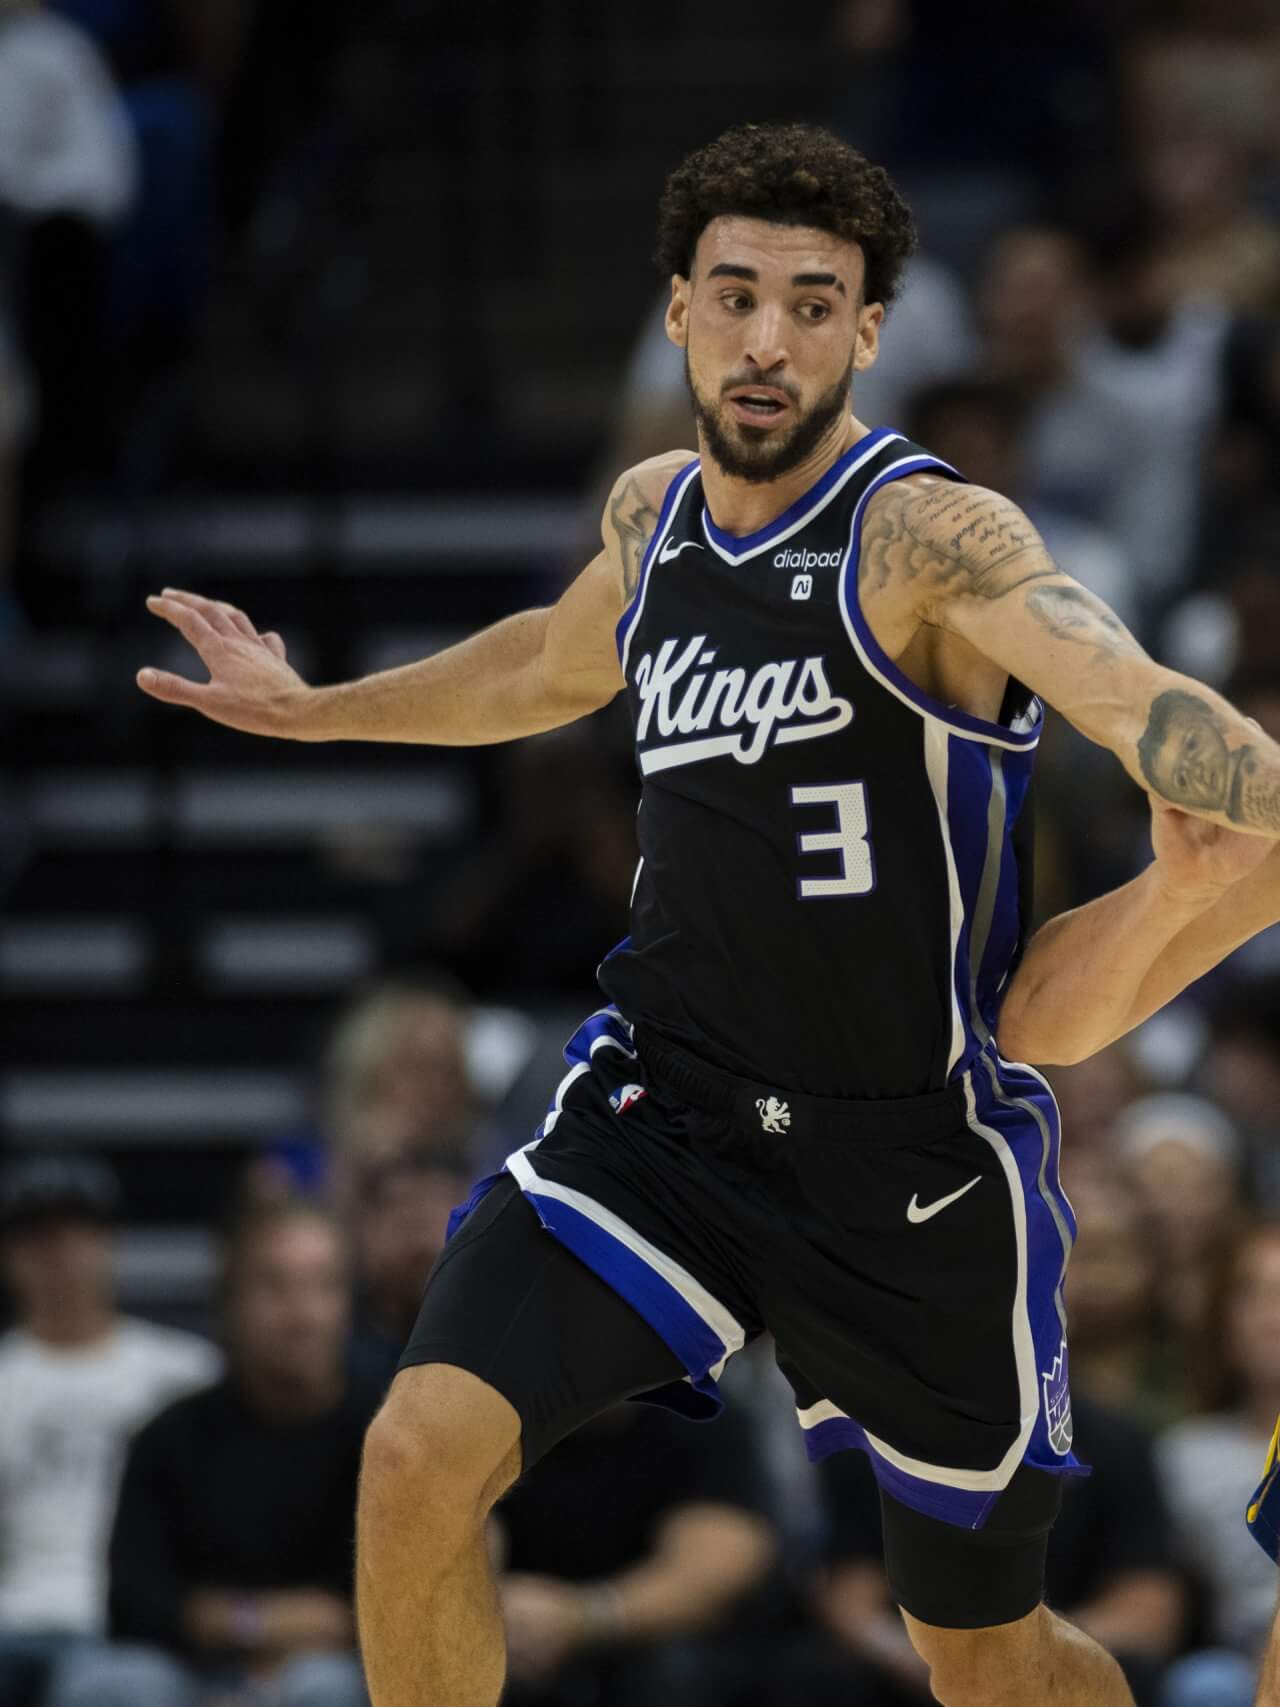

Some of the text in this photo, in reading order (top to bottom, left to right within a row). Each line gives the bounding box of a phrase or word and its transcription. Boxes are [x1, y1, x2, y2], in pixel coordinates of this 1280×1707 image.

[773, 547, 843, 573] dialpad
[635, 633, 854, 775] Kings
[789, 780, 877, 899] 3
